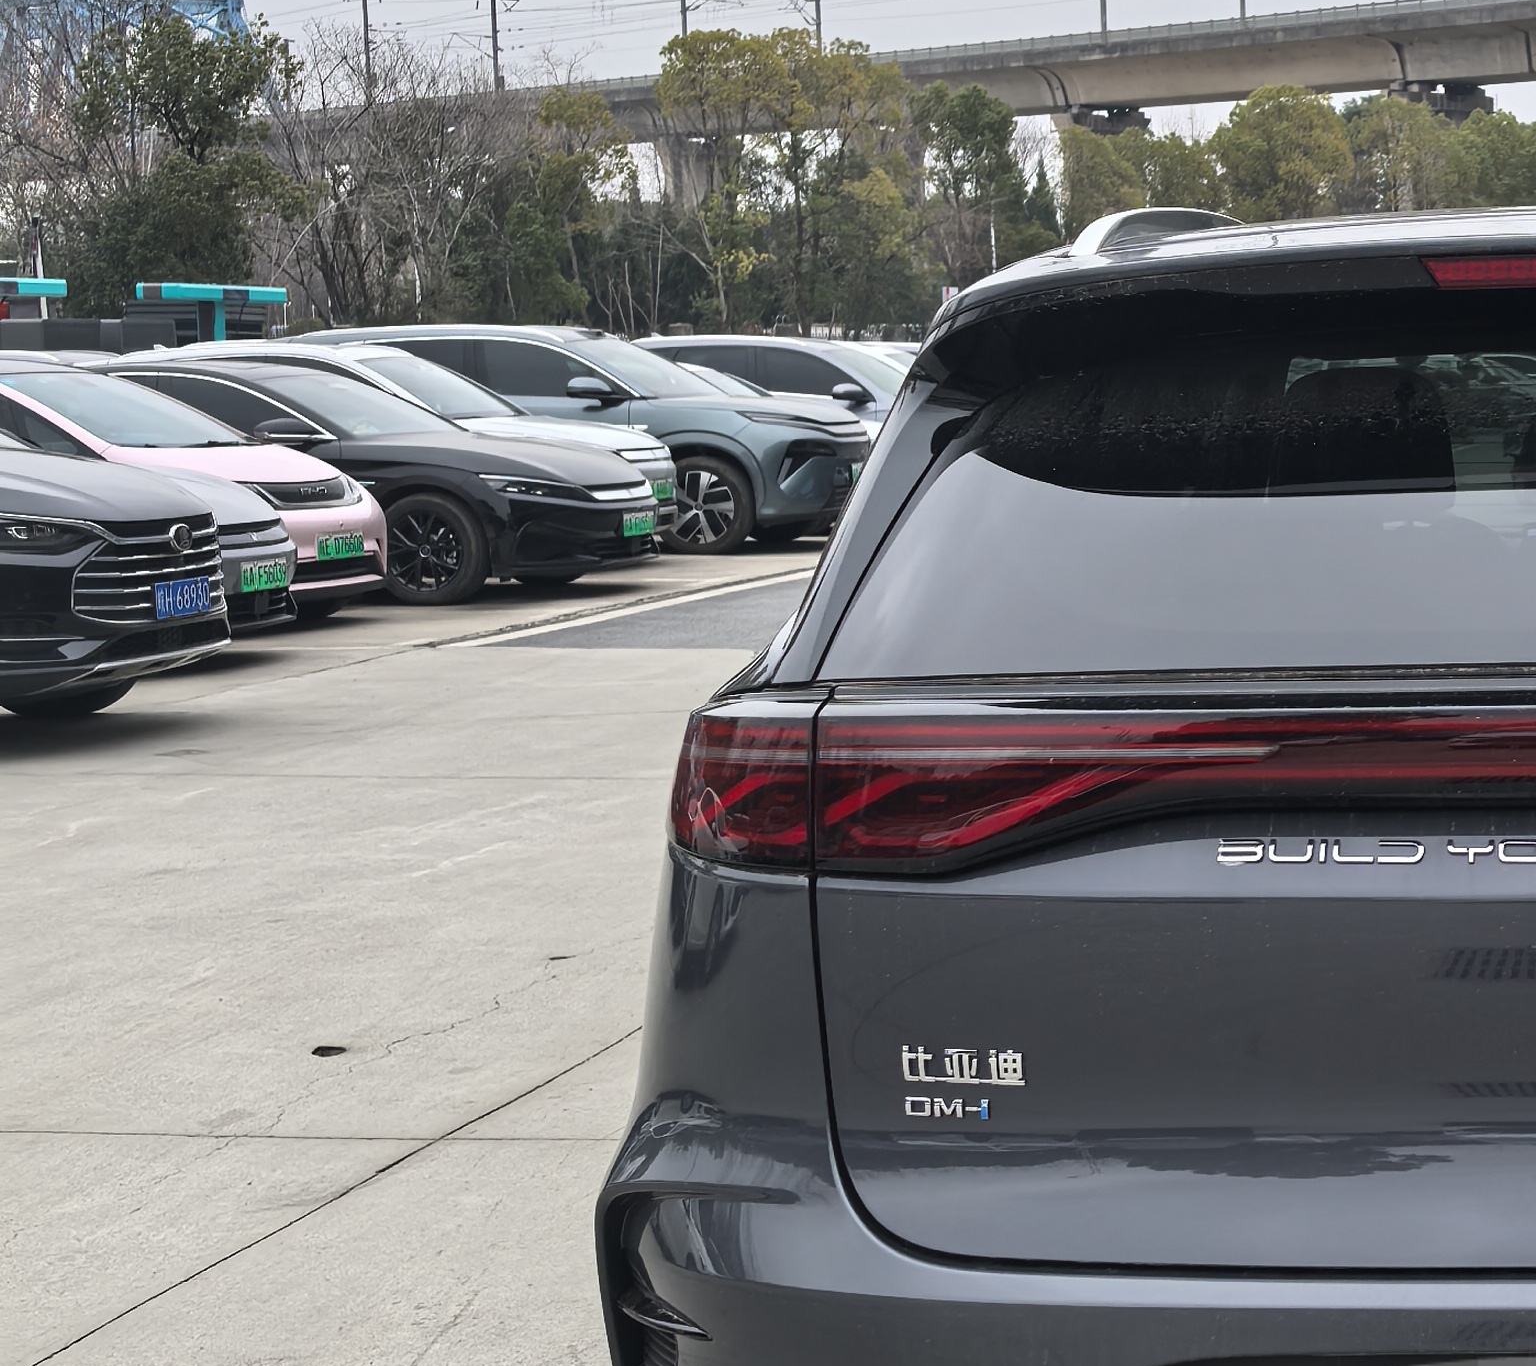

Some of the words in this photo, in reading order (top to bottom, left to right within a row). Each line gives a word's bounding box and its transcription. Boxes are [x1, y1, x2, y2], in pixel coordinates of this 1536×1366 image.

[1217, 837, 1426, 866] BUILD
[902, 1044, 1026, 1087] 比亚迪
